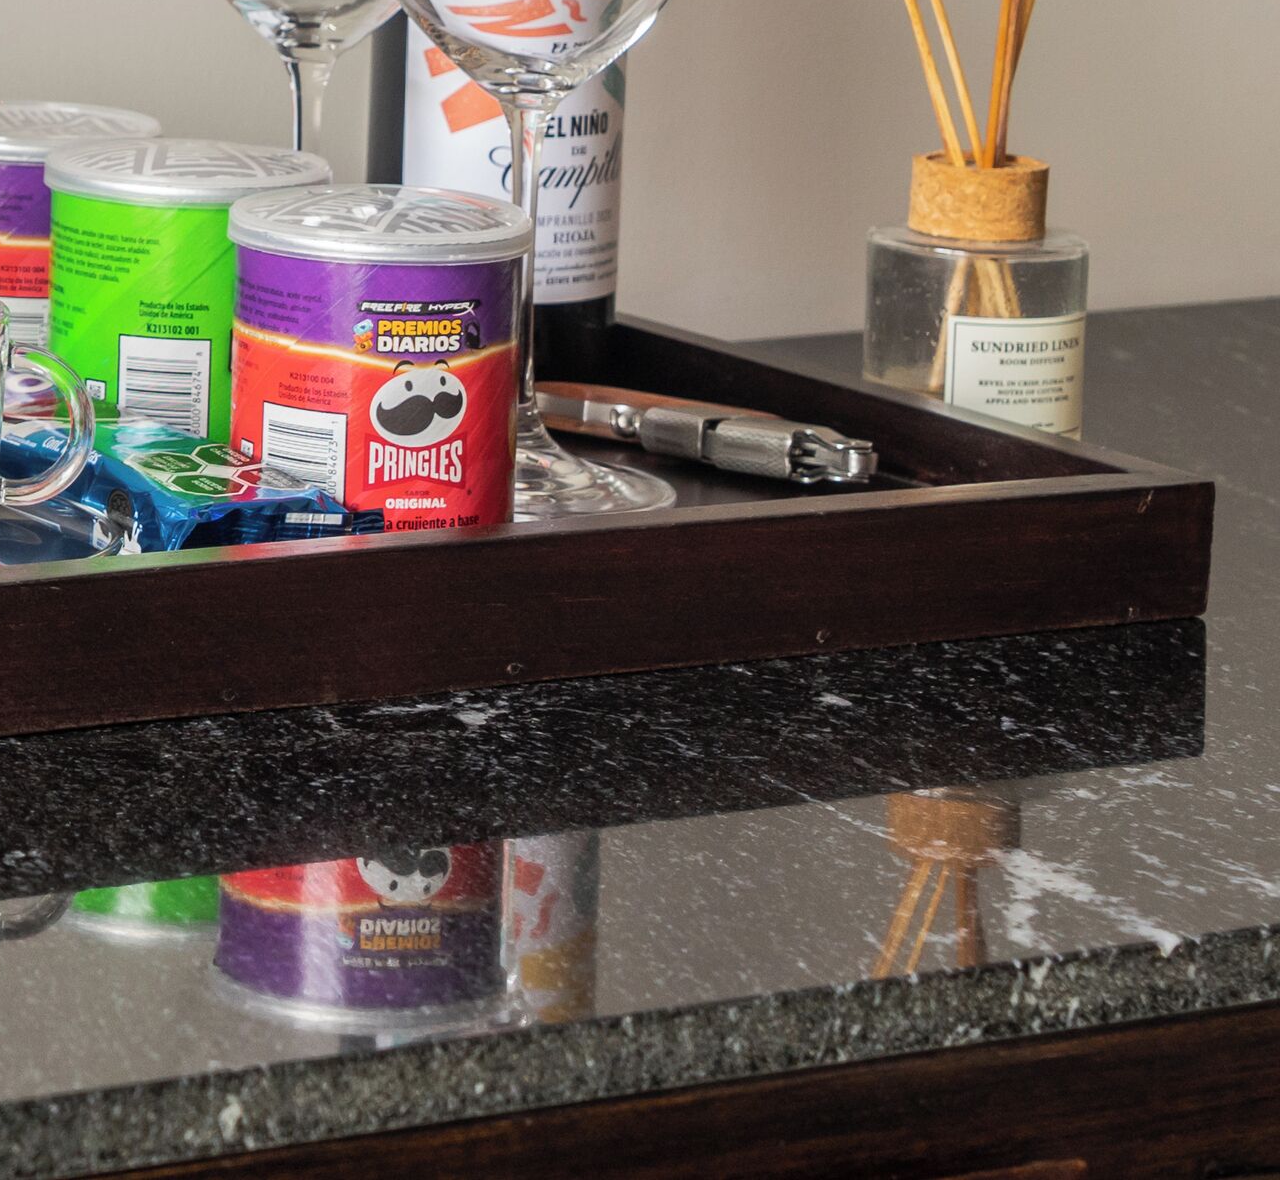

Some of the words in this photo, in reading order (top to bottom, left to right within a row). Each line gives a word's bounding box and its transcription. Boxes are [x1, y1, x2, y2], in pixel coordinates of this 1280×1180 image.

[544, 116, 567, 138] EL
[570, 108, 609, 137] NIÑO
[488, 132, 623, 209] Campill
[553, 227, 595, 244] RIOJA
[146, 322, 183, 335] K213102
[184, 325, 200, 335] 001
[377, 319, 462, 336] PREMIOS
[376, 335, 461, 352] DIARIOS
[970, 340, 1049, 354] SUNDRIED
[367, 439, 463, 485] PRINGLES
[384, 497, 447, 510] ORIGINAL
[395, 515, 447, 531] crujiente
[448, 517, 456, 528] a
[457, 514, 480, 527] base
